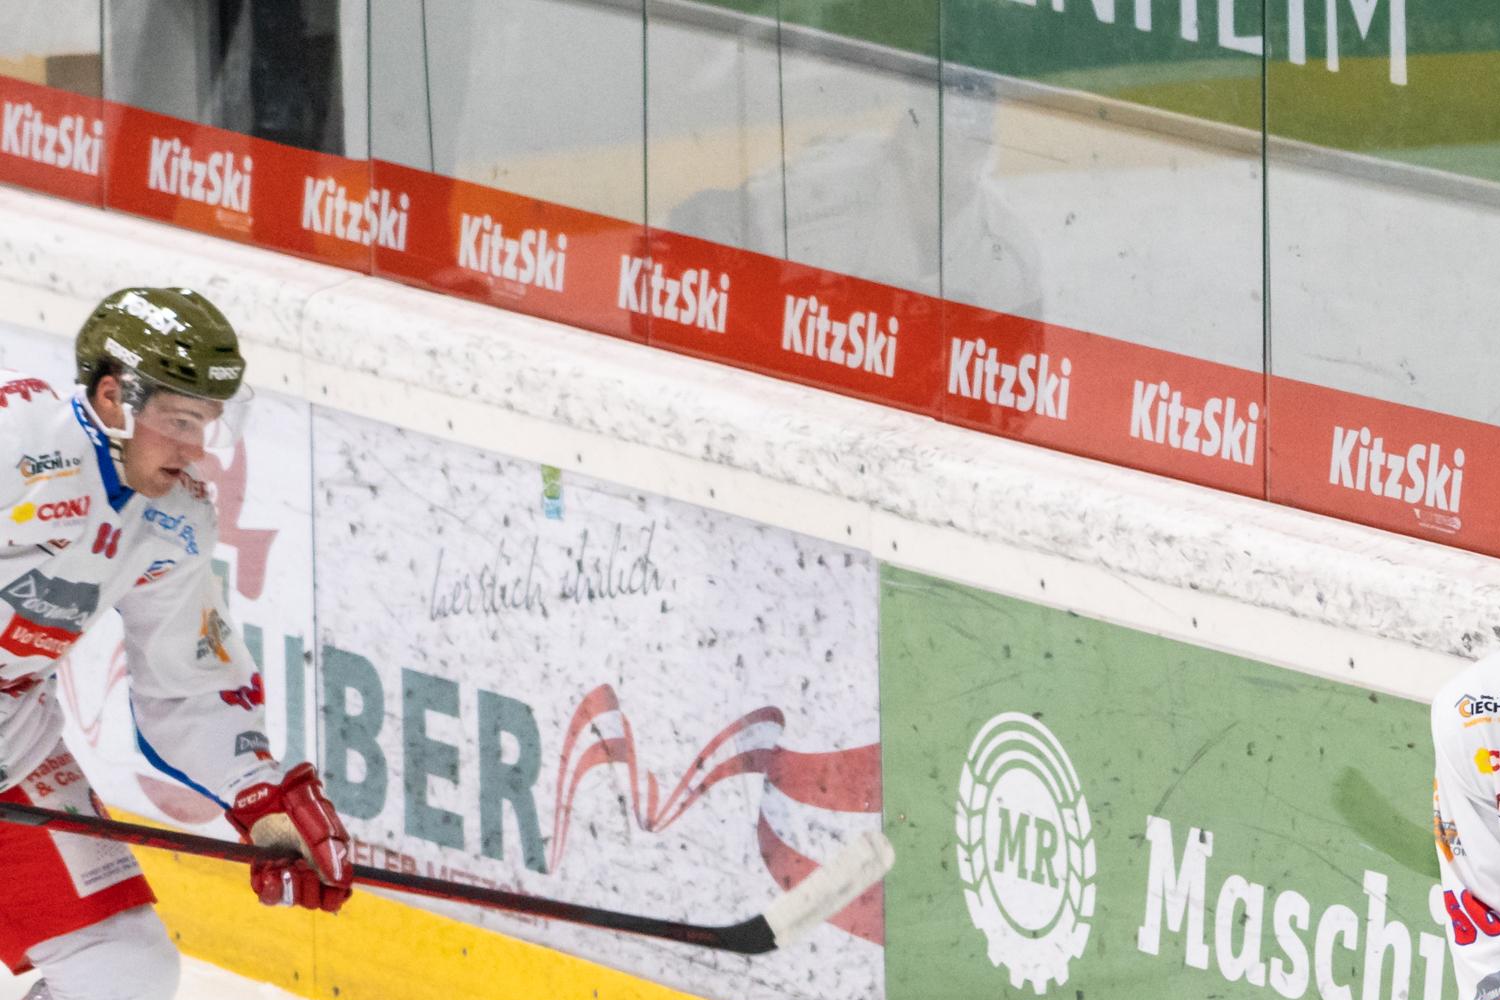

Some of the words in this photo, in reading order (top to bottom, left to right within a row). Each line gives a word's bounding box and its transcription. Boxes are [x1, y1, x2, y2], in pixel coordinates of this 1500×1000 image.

[2, 103, 102, 176] KitzSki
[148, 136, 253, 213] KitzSki
[303, 176, 410, 252] KitzSki
[459, 213, 568, 292] KitzSki
[617, 254, 730, 333] KitzSki
[782, 295, 899, 379] KitzSki
[949, 338, 1072, 422] KitzSki
[1130, 380, 1260, 466] KitzSki
[1329, 425, 1465, 514] KitzSki
[242, 618, 548, 874] UBER
[994, 808, 1060, 890] MR
